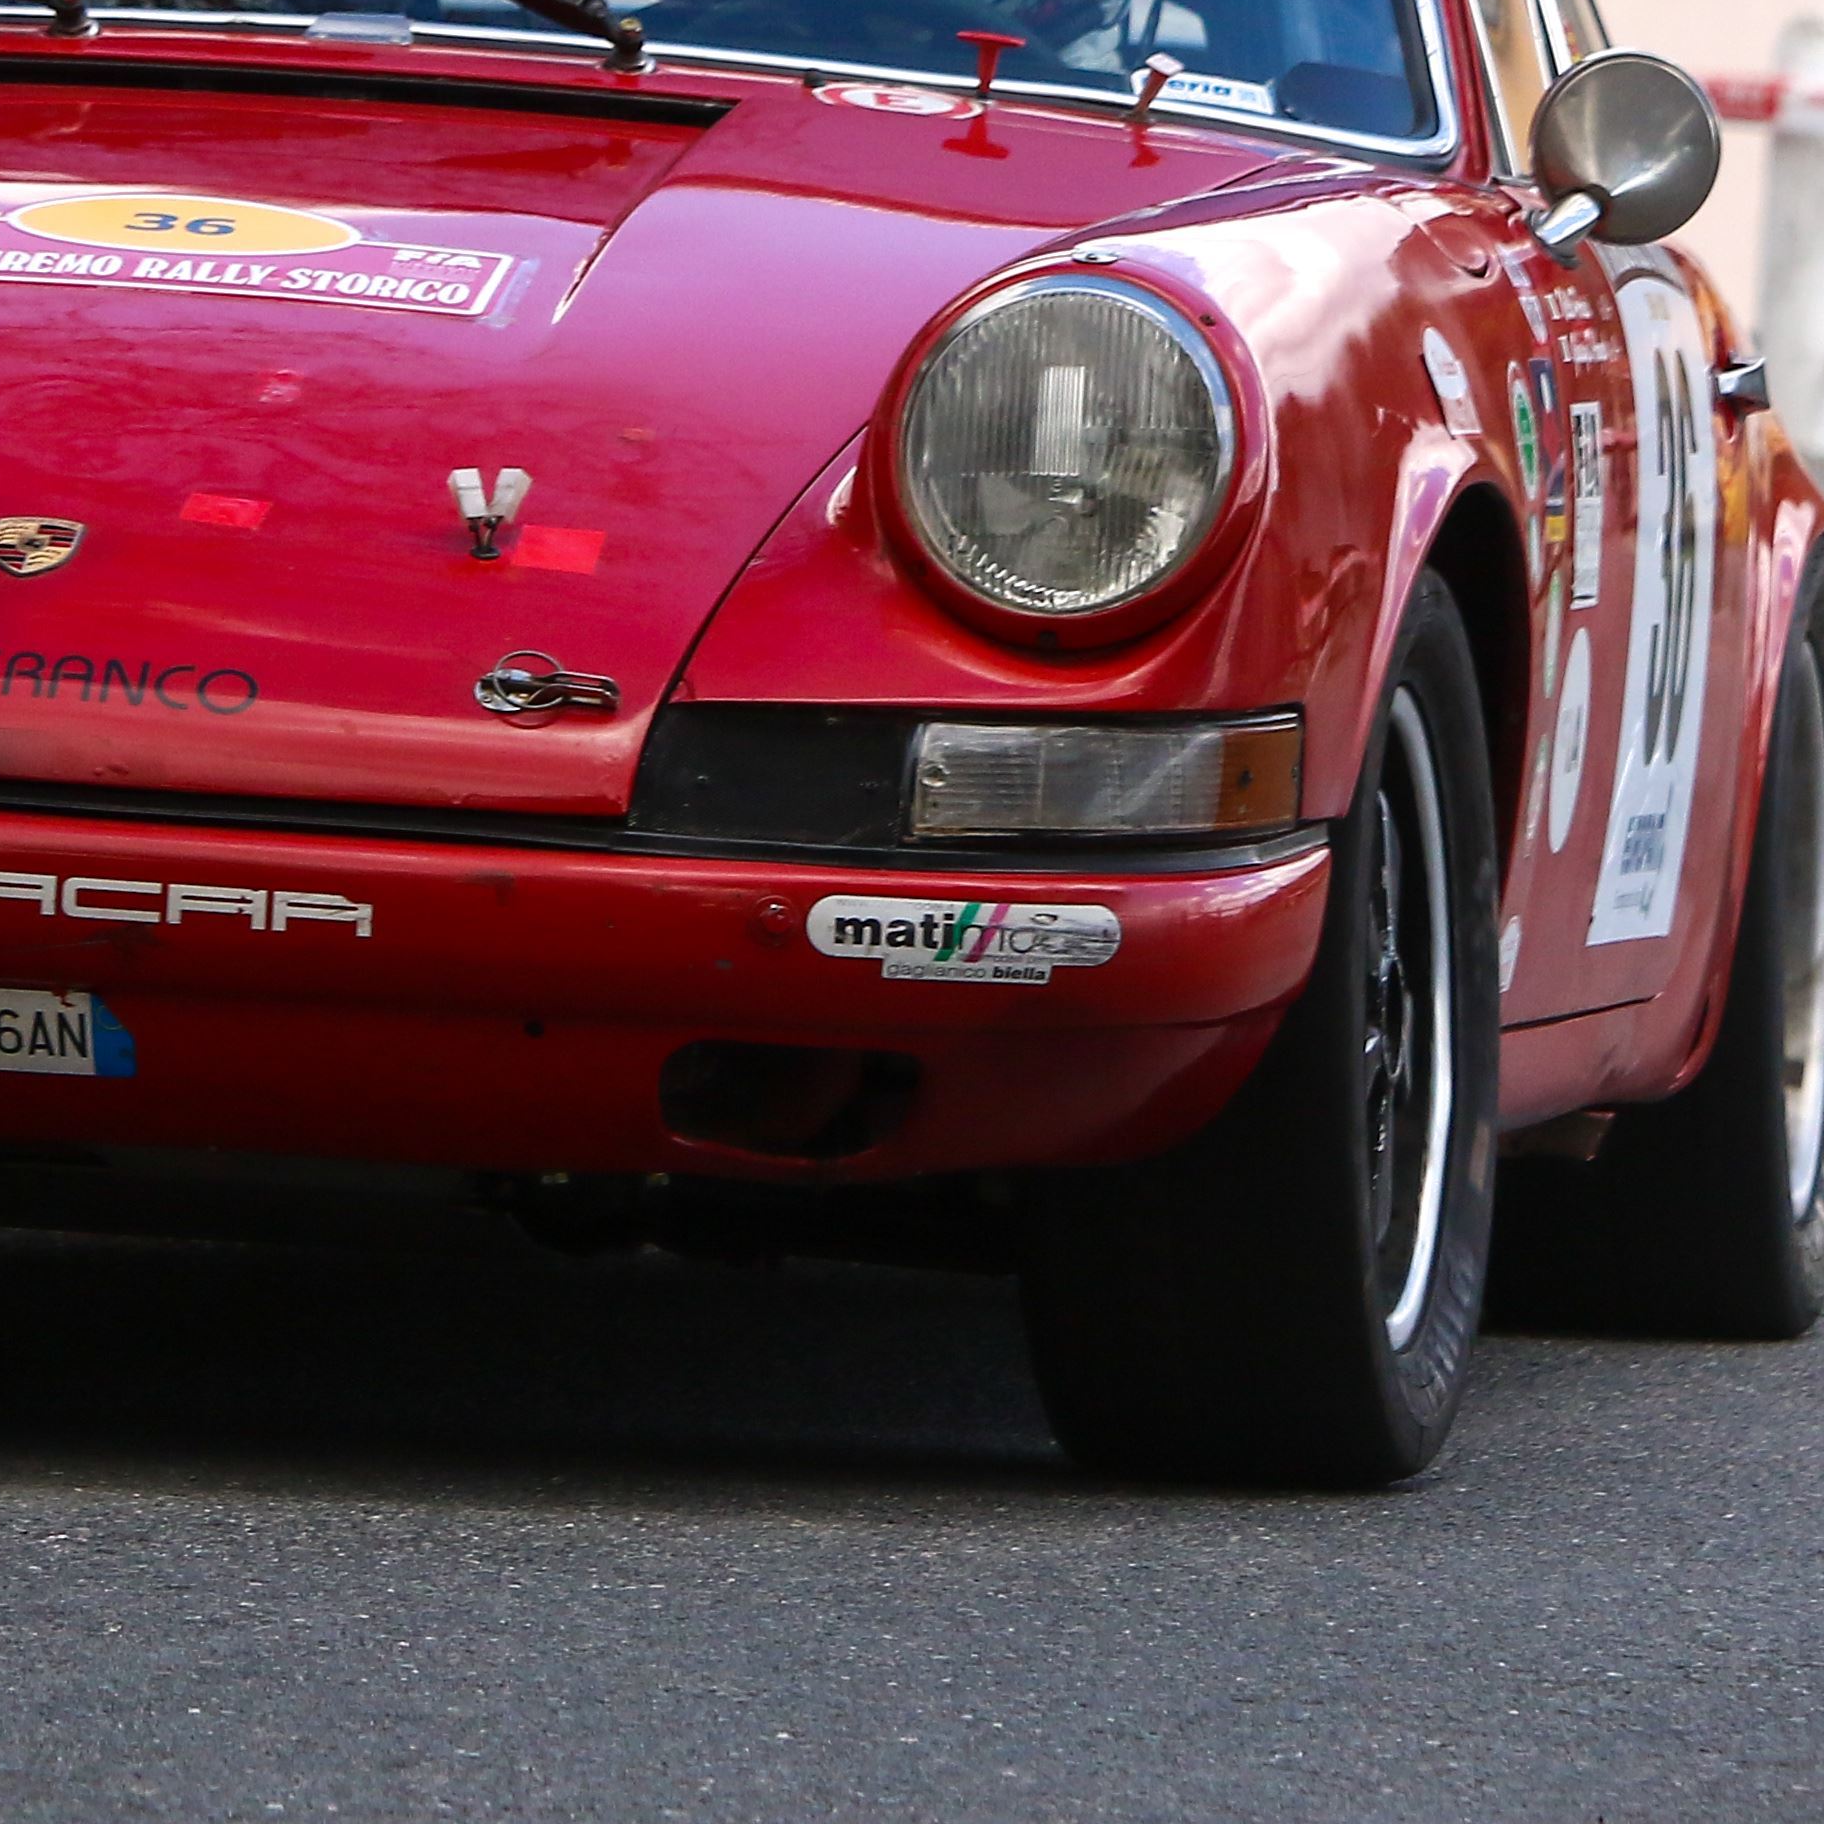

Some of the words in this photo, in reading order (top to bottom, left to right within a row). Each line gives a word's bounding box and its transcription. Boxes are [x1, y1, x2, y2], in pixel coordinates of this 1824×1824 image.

[125, 213, 236, 236] 36
[131, 256, 279, 287] RALLY
[281, 267, 471, 306] STORICO
[992, 966, 1047, 981] biella
